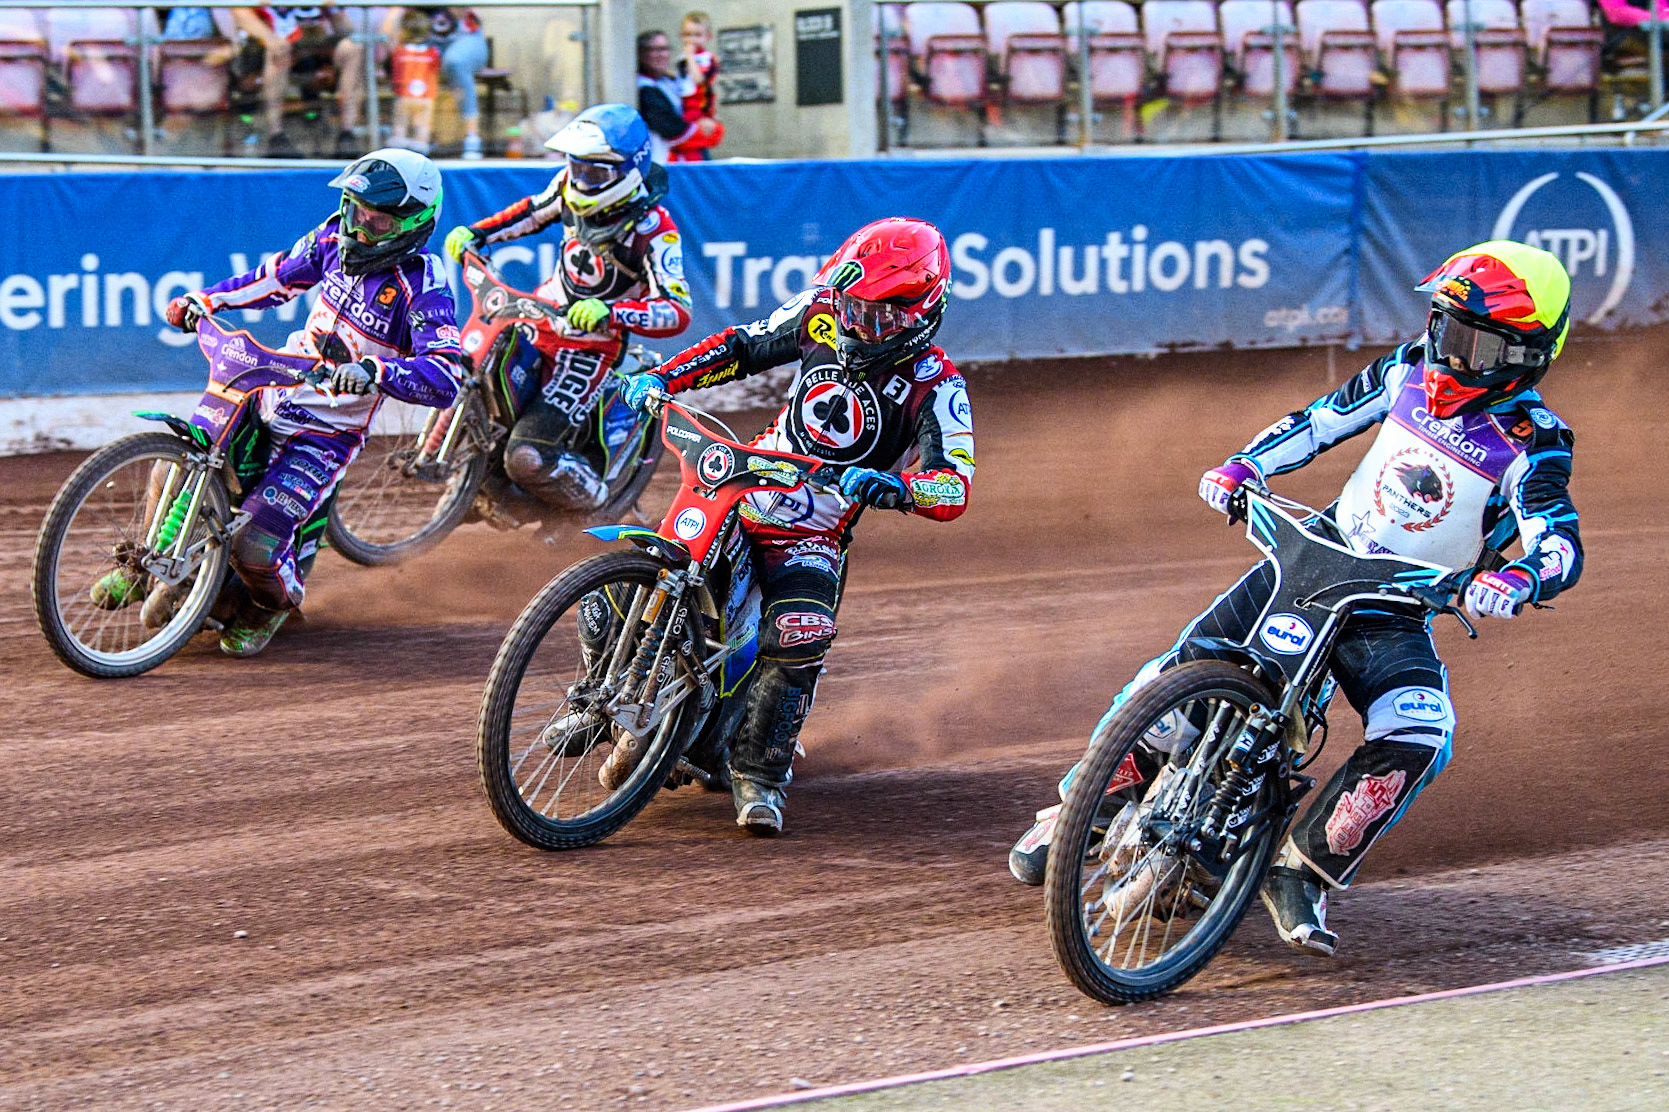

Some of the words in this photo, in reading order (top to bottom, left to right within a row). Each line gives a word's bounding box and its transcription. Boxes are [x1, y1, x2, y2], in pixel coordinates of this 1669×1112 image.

[703, 241, 835, 309] Tra
[950, 224, 1270, 300] Solutions
[379, 286, 398, 304] 3
[221, 343, 258, 367] Crendon
[805, 370, 838, 388] BELLE
[861, 398, 876, 431] ACES
[1411, 406, 1487, 462] Crendon
[1438, 437, 1481, 467] ENGINEERING
[1382, 484, 1432, 518] PANTHERS
[680, 517, 700, 531] ATPI
[672, 608, 688, 634] GEO
[780, 615, 834, 628] CBS
[1267, 625, 1307, 647] eurol
[1400, 700, 1442, 714] eurol
